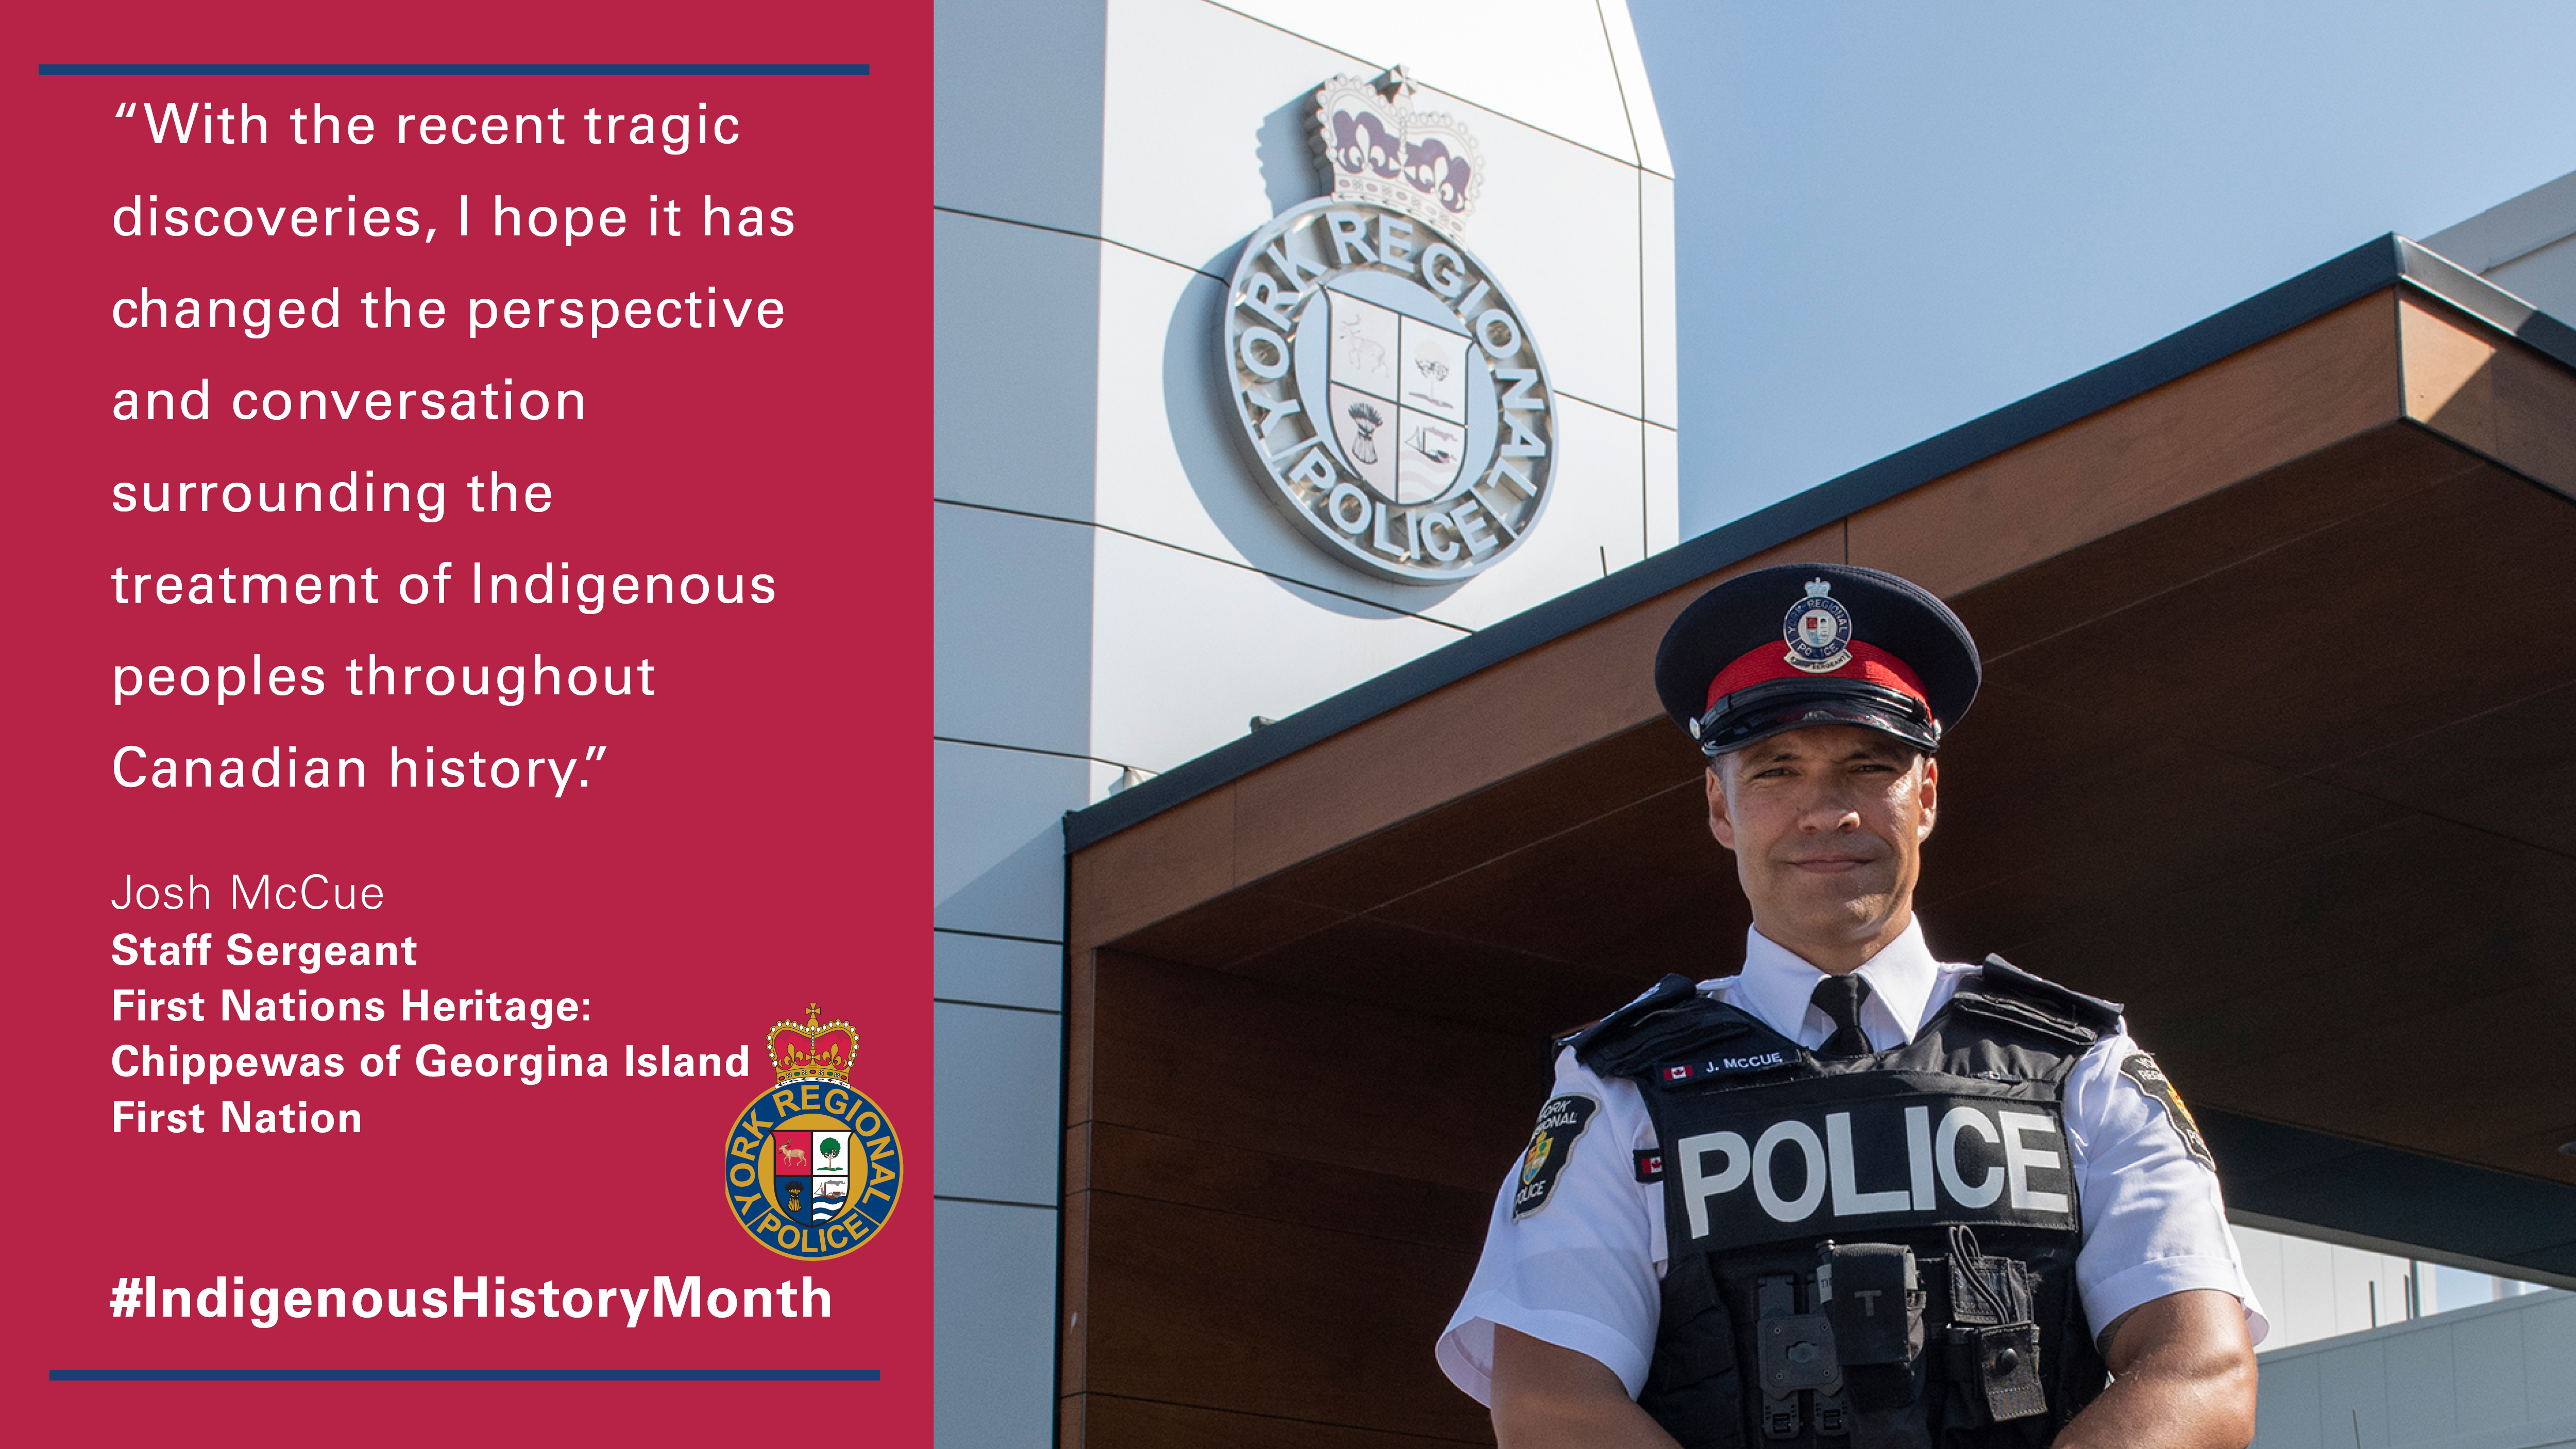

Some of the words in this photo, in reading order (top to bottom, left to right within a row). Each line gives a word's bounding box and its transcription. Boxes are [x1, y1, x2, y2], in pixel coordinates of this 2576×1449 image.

[1240, 231, 1328, 438] YORK
[1326, 211, 1546, 498] REGIONAL
[1289, 447, 1499, 563] POLICE
[1788, 605, 1802, 634] YORK
[1807, 599, 1848, 633] REGIONAL
[1706, 1061, 1720, 1073] J.
[1722, 1052, 1782, 1069] MCCUE
[1677, 1106, 2069, 1239] POLICE
[1853, 1289, 1883, 1317] T
